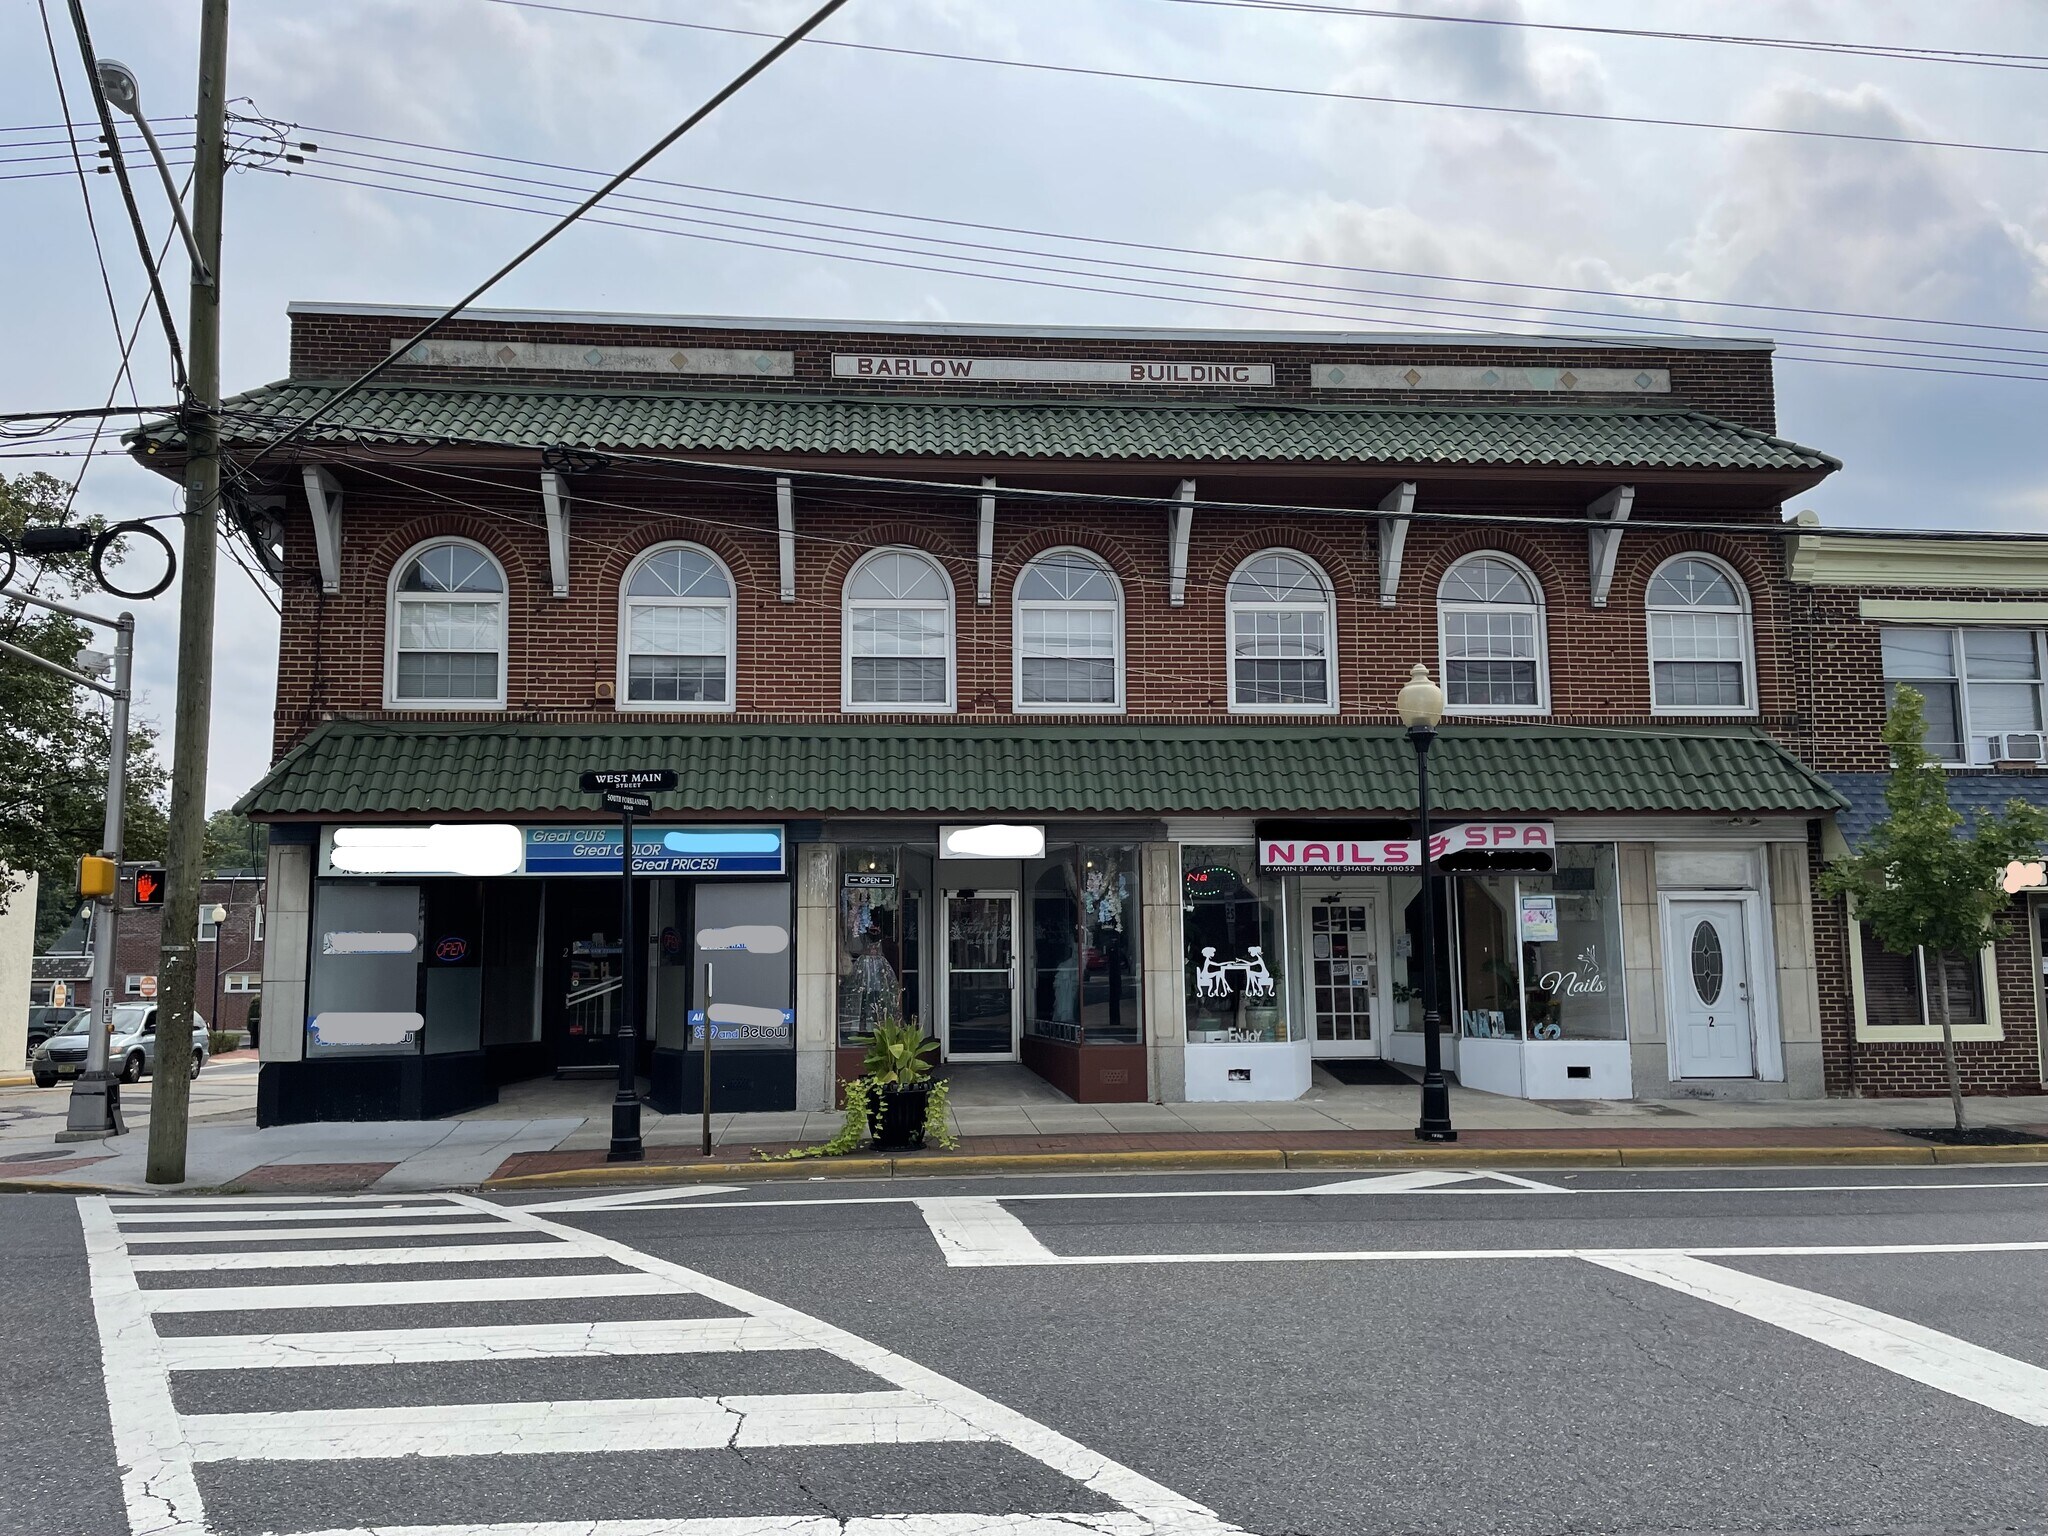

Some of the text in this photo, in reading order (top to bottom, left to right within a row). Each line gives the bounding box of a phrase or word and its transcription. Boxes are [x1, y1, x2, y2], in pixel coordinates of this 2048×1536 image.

[857, 358, 1250, 382] BARLOW BUILDING
[595, 773, 662, 783] WEST MAIN
[607, 793, 622, 803] SOUTH
[533, 830, 606, 842] Great CUTS
[573, 844, 612, 856] Great
[1268, 843, 1409, 863] NAILS
[1464, 826, 1548, 846] SPA
[631, 858, 719, 871] Great PRICES!
[859, 876, 880, 884] OPEN
[435, 941, 467, 957] OPEN
[562, 947, 569, 958] 2
[1539, 970, 1606, 997] Nails
[1708, 1015, 1715, 1028] 2
[718, 1028, 739, 1039] and
